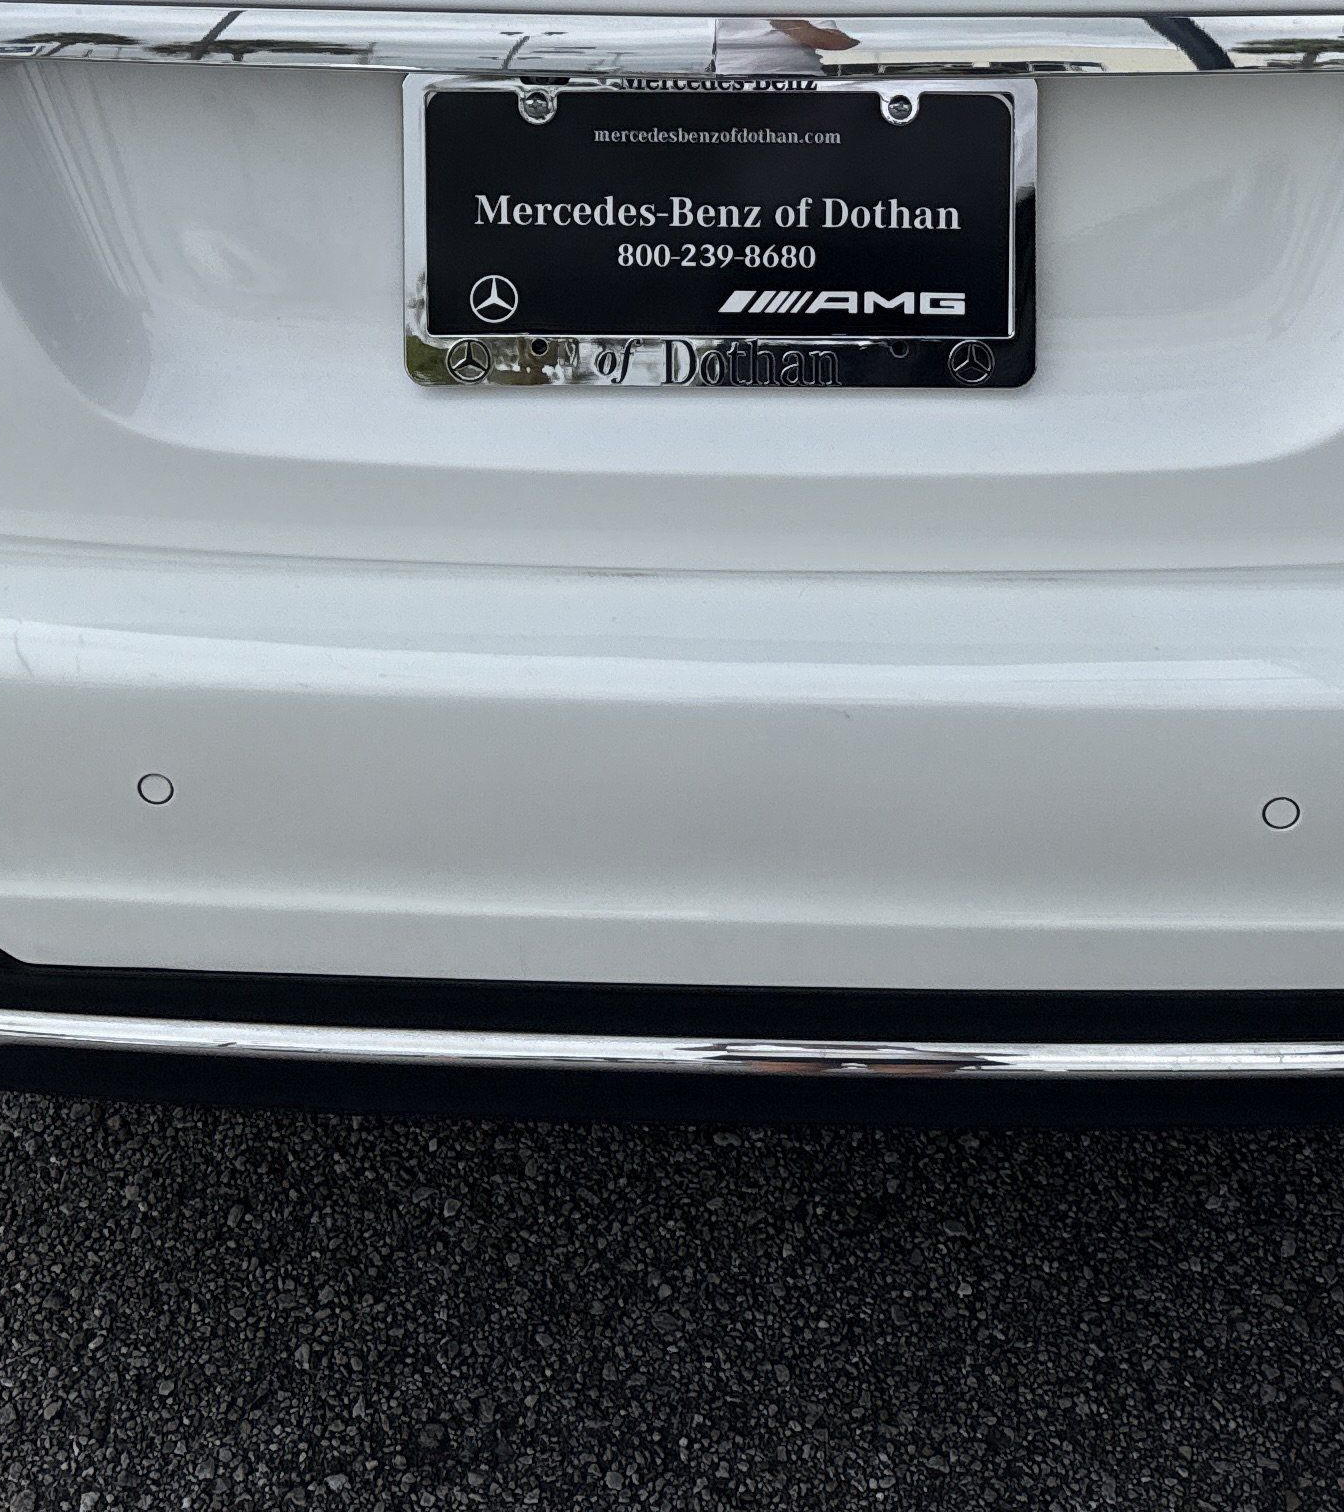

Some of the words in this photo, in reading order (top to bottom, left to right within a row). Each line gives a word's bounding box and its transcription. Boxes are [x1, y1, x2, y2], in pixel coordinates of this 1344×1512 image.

[593, 127, 843, 145] mercedesbenzofdothan.com
[474, 194, 762, 229] Mercedes-Benz
[774, 196, 812, 229] of
[821, 197, 963, 231] Dothan
[617, 243, 817, 270] 800-239-8680
[806, 290, 967, 316] AMG
[594, 338, 642, 385] of
[660, 338, 843, 387] Dothan
